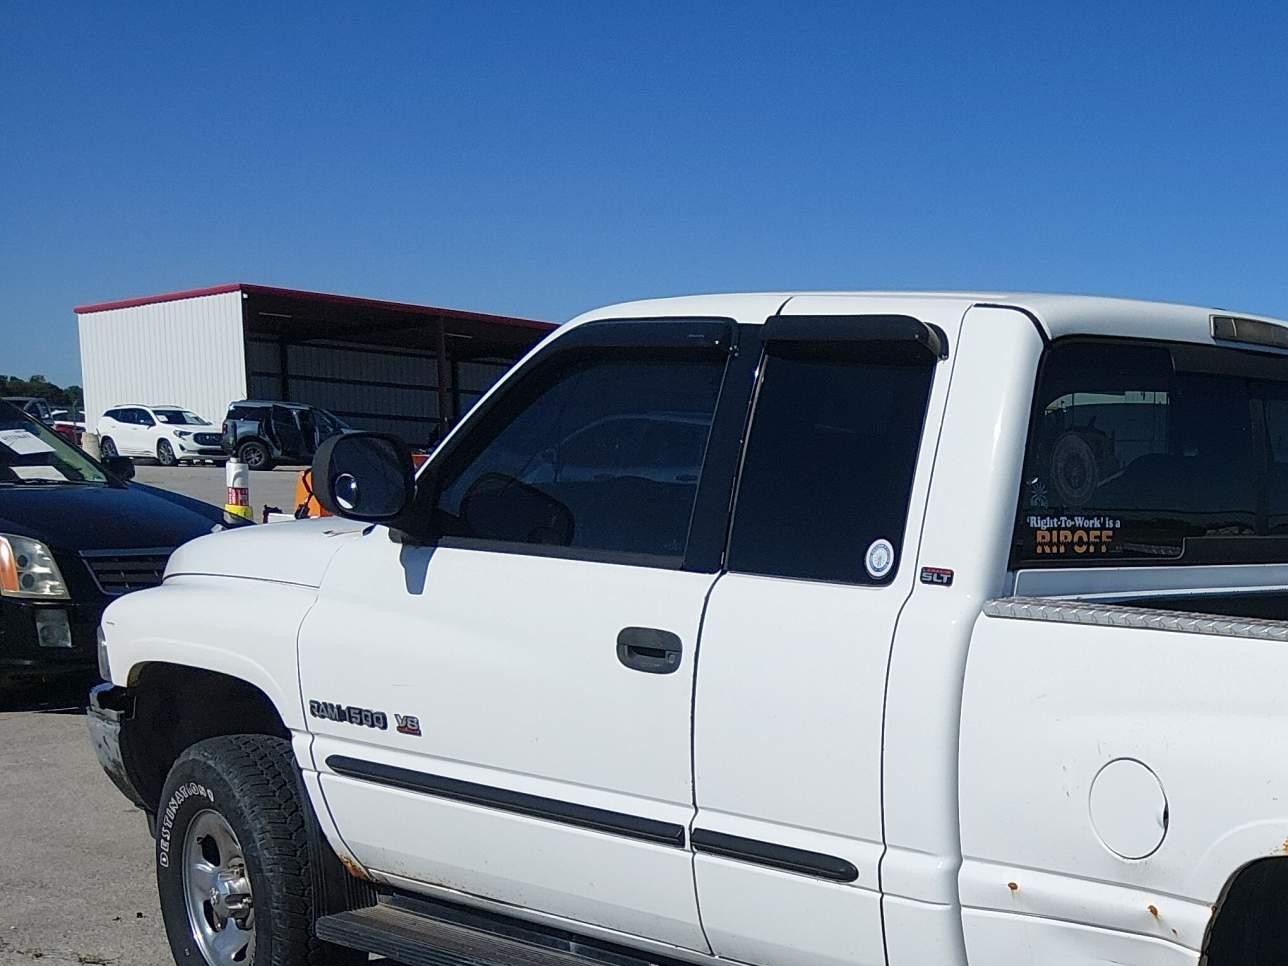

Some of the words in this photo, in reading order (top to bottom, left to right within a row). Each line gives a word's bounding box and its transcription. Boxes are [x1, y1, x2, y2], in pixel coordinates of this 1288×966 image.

[1106, 517, 1113, 528] is
[1115, 519, 1121, 528] a
[1036, 530, 1113, 554] RIPOFF
[922, 572, 951, 583] SLT
[309, 700, 342, 722] RAM
[344, 706, 388, 730] 1500
[394, 714, 420, 732] V8
[160, 782, 207, 868] DESTINATION
